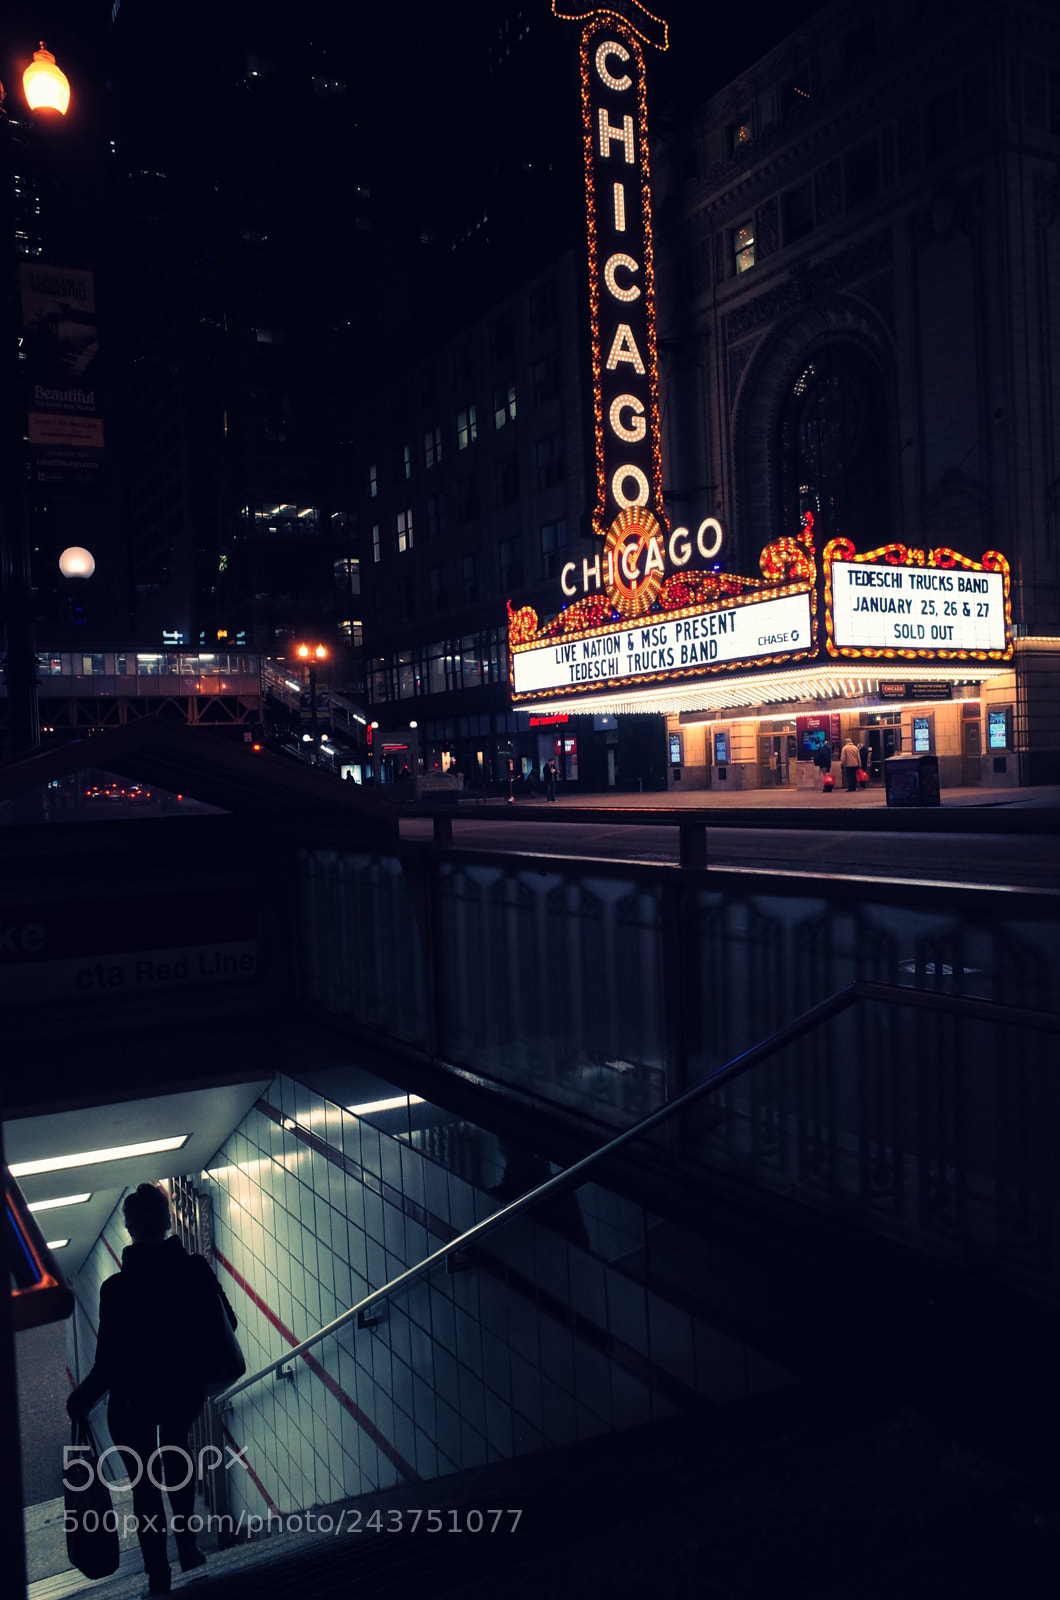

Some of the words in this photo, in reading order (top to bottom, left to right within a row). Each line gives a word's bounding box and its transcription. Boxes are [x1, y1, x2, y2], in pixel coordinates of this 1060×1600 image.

[595, 41, 650, 508] CHICAGO
[33, 384, 95, 405] Beautiful
[561, 518, 722, 596] CHICAGO
[848, 570, 902, 589] TEDESCHI
[908, 574, 954, 591] TRUCKS
[957, 578, 989, 594] BAND
[853, 597, 912, 614] JANUARY
[920, 600, 938, 617] 25,
[943, 601, 957, 616] 26
[963, 602, 971, 617] &
[976, 603, 990, 617] 27
[555, 644, 577, 664] LIVE
[583, 635, 621, 659] NATION
[627, 633, 635, 651] &
[641, 626, 667, 649] MSG
[675, 611, 737, 642] PRESENT
[758, 632, 789, 646] CHASE
[894, 623, 925, 639] SOLD
[931, 625, 954, 640] OUT
[569, 656, 619, 682] TEDESCHI
[627, 647, 675, 672] TRUCKS
[681, 639, 718, 664] BAND
[76, 963, 125, 990] cta
[136, 956, 189, 982] Red
[200, 949, 254, 976] Line
